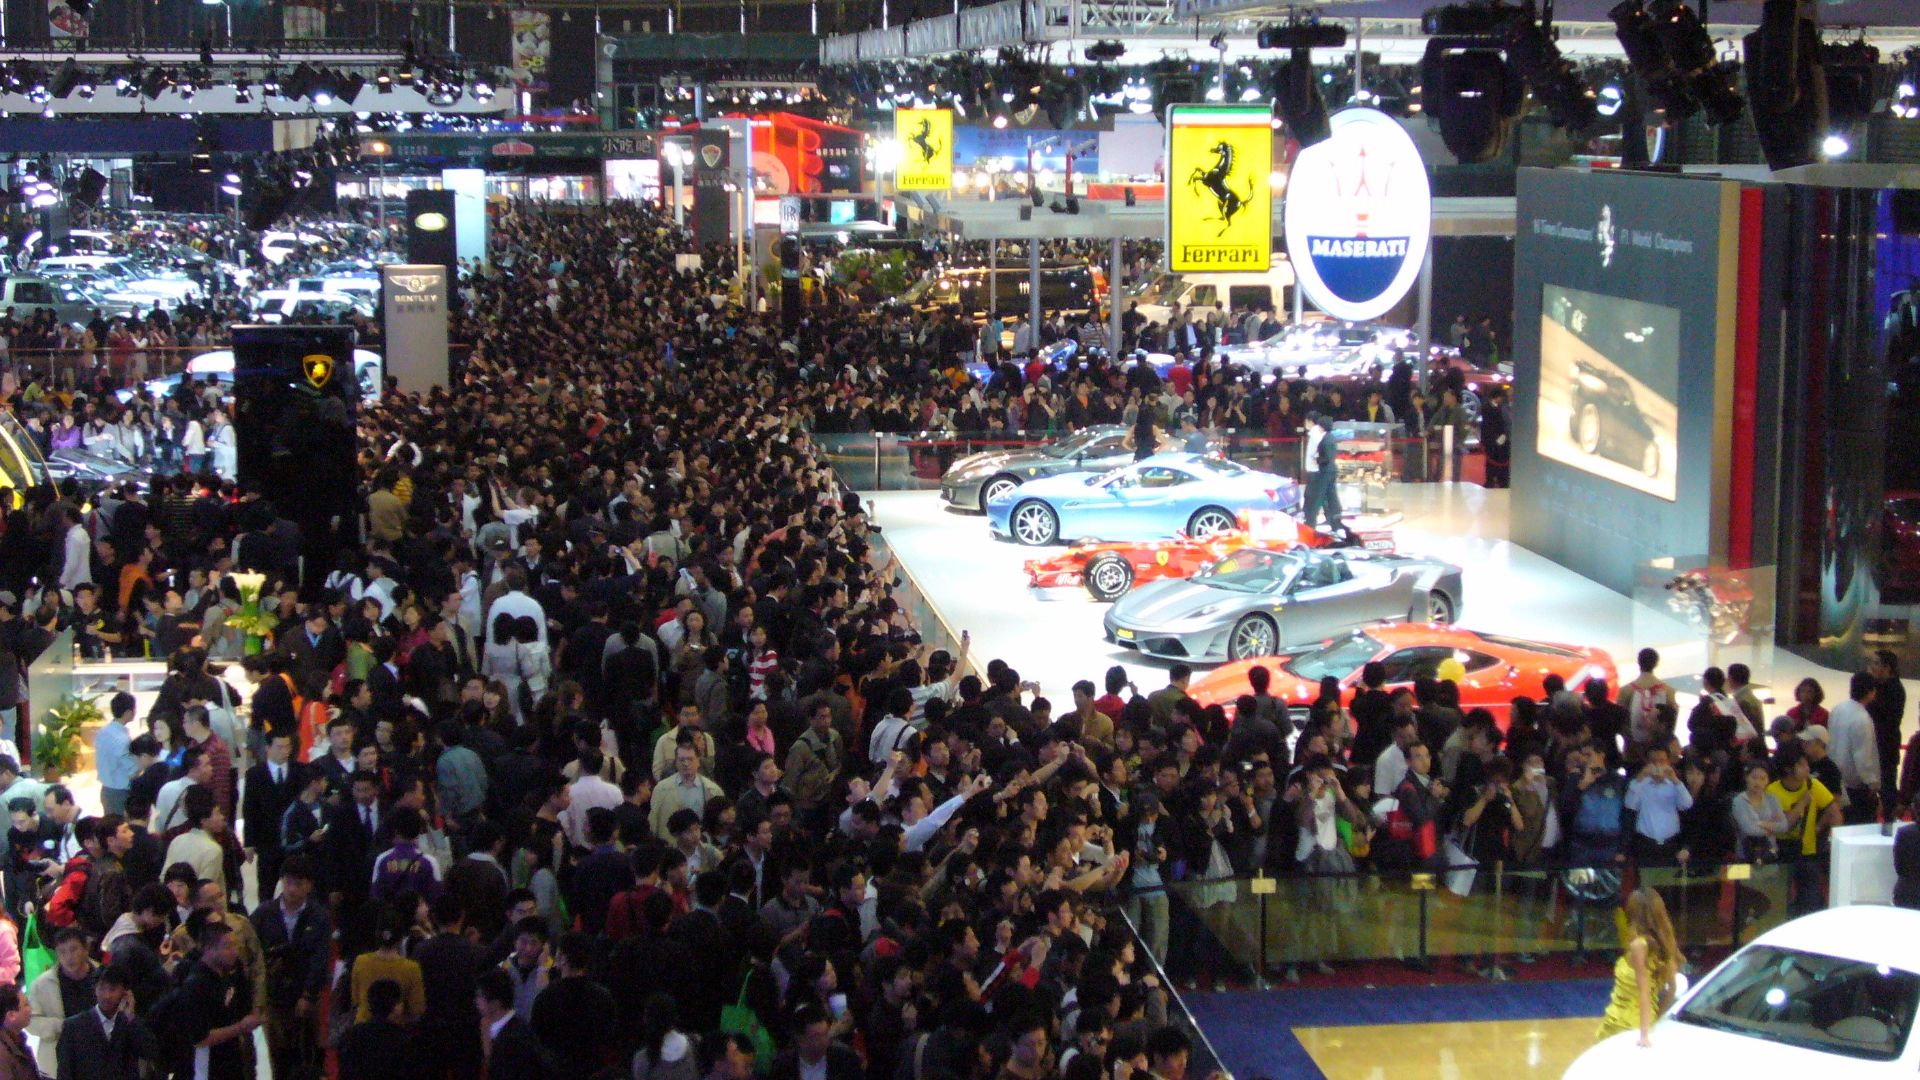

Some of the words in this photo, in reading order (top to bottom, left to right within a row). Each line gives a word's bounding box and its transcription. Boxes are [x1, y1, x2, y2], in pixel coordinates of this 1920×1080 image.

[602, 138, 652, 153] 小吃吧
[902, 175, 946, 185] Ferrari
[1181, 244, 1260, 263] Ferrari
[1311, 238, 1407, 258] MASERATI
[394, 295, 438, 303] BENTLEY
